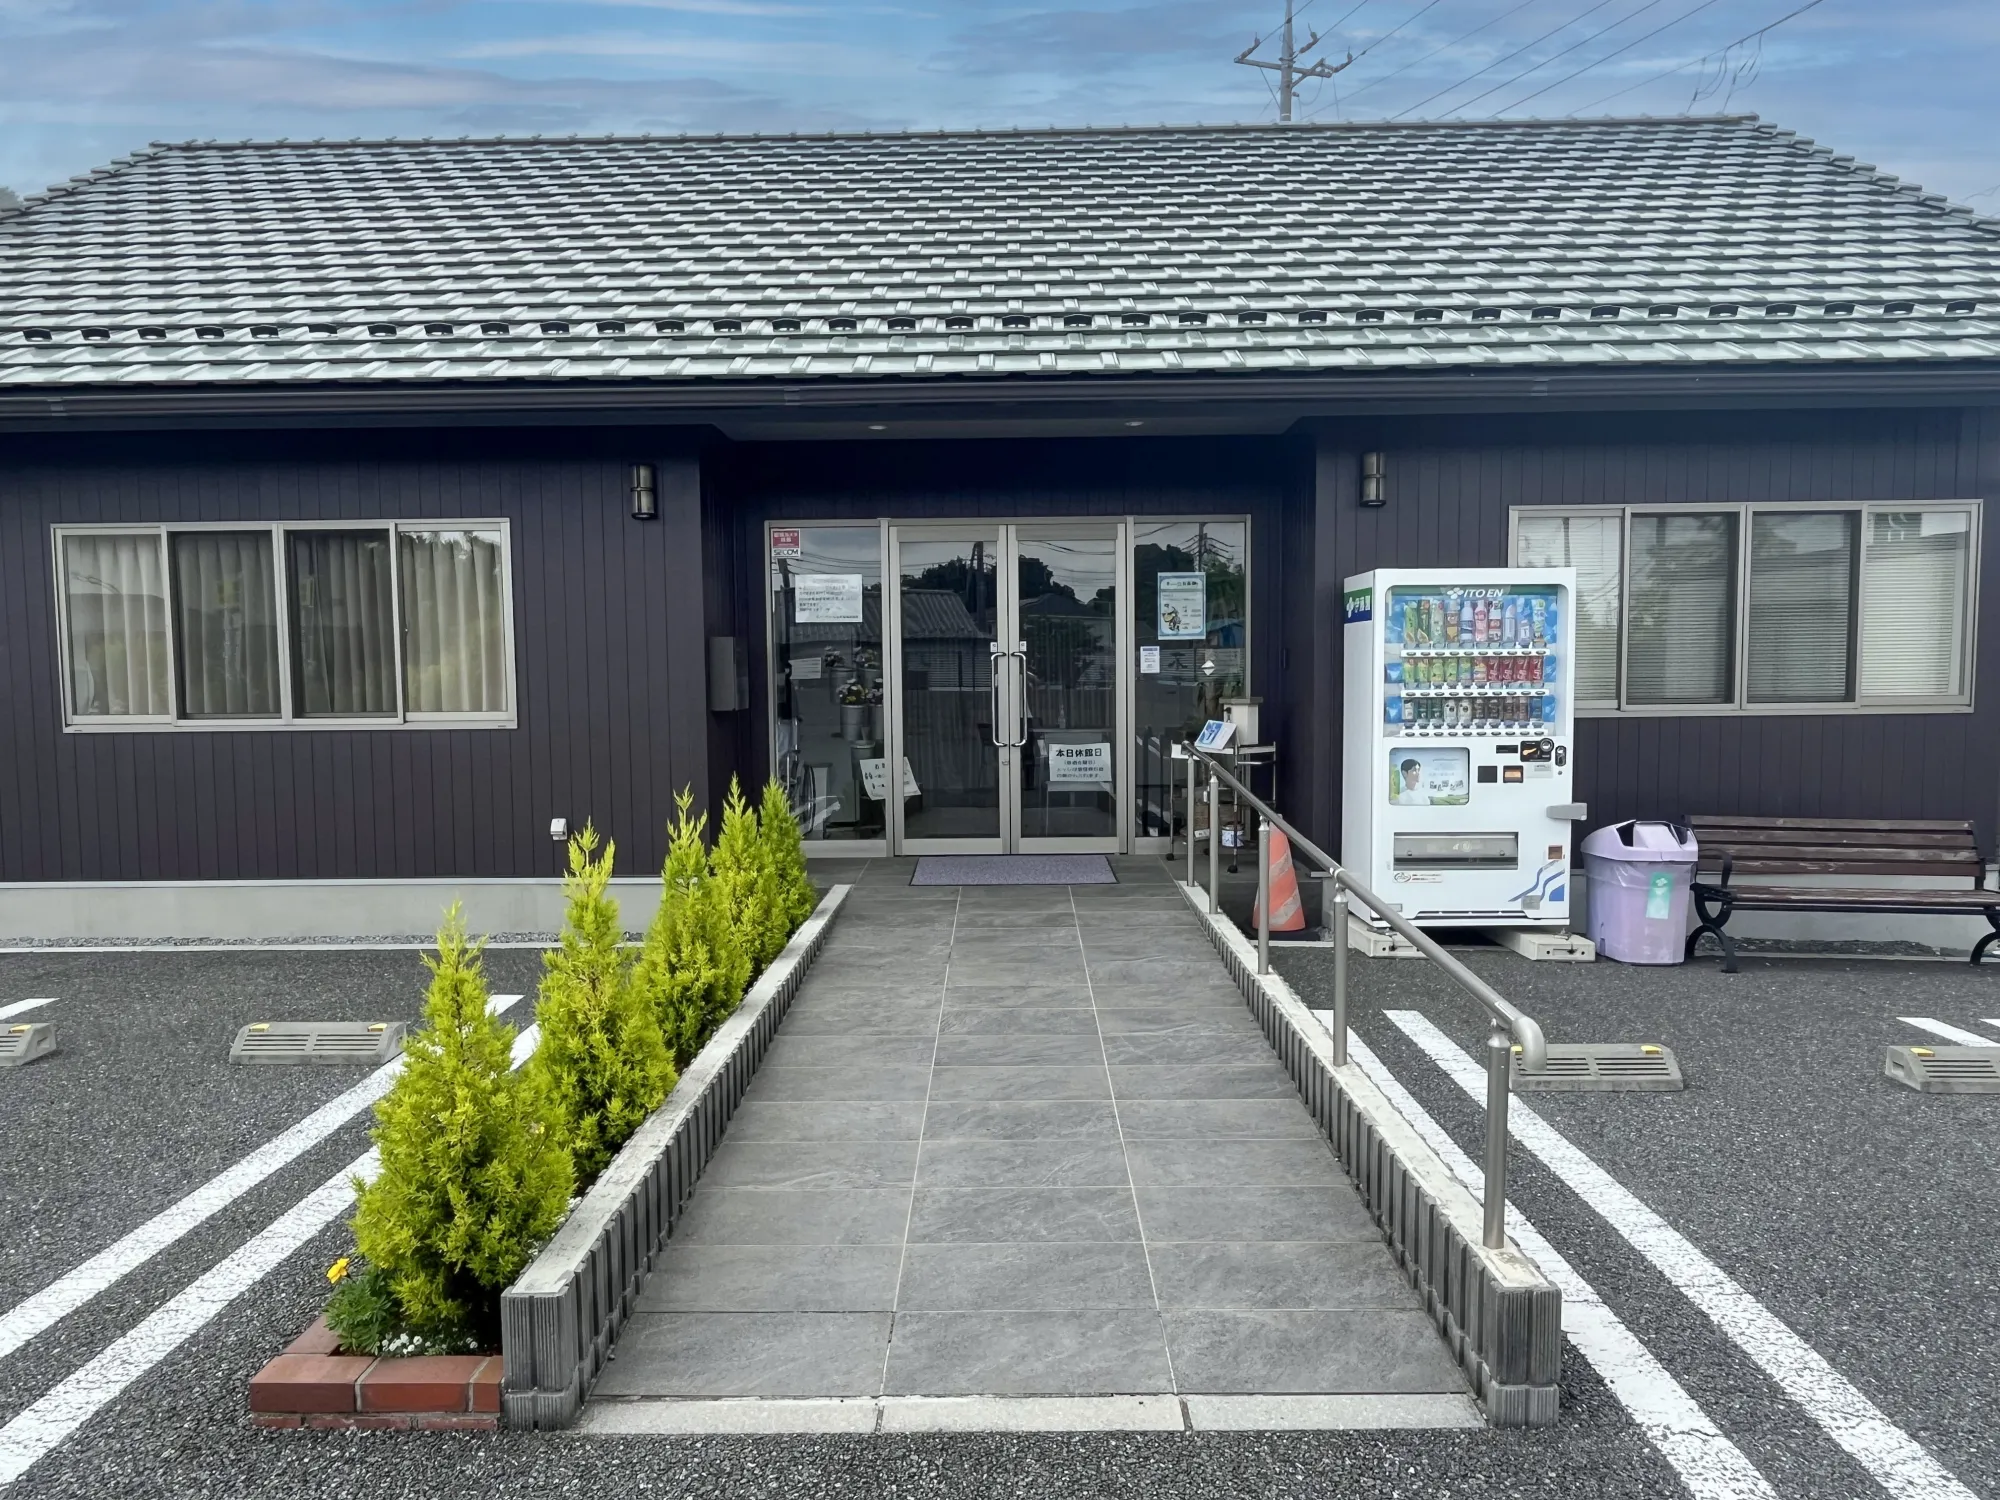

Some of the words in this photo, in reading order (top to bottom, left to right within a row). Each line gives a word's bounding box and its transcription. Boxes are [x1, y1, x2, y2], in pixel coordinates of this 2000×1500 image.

[1464, 588, 1486, 598] ITO
[1486, 588, 1504, 598] EN
[1056, 748, 1102, 758] 本日休館日
